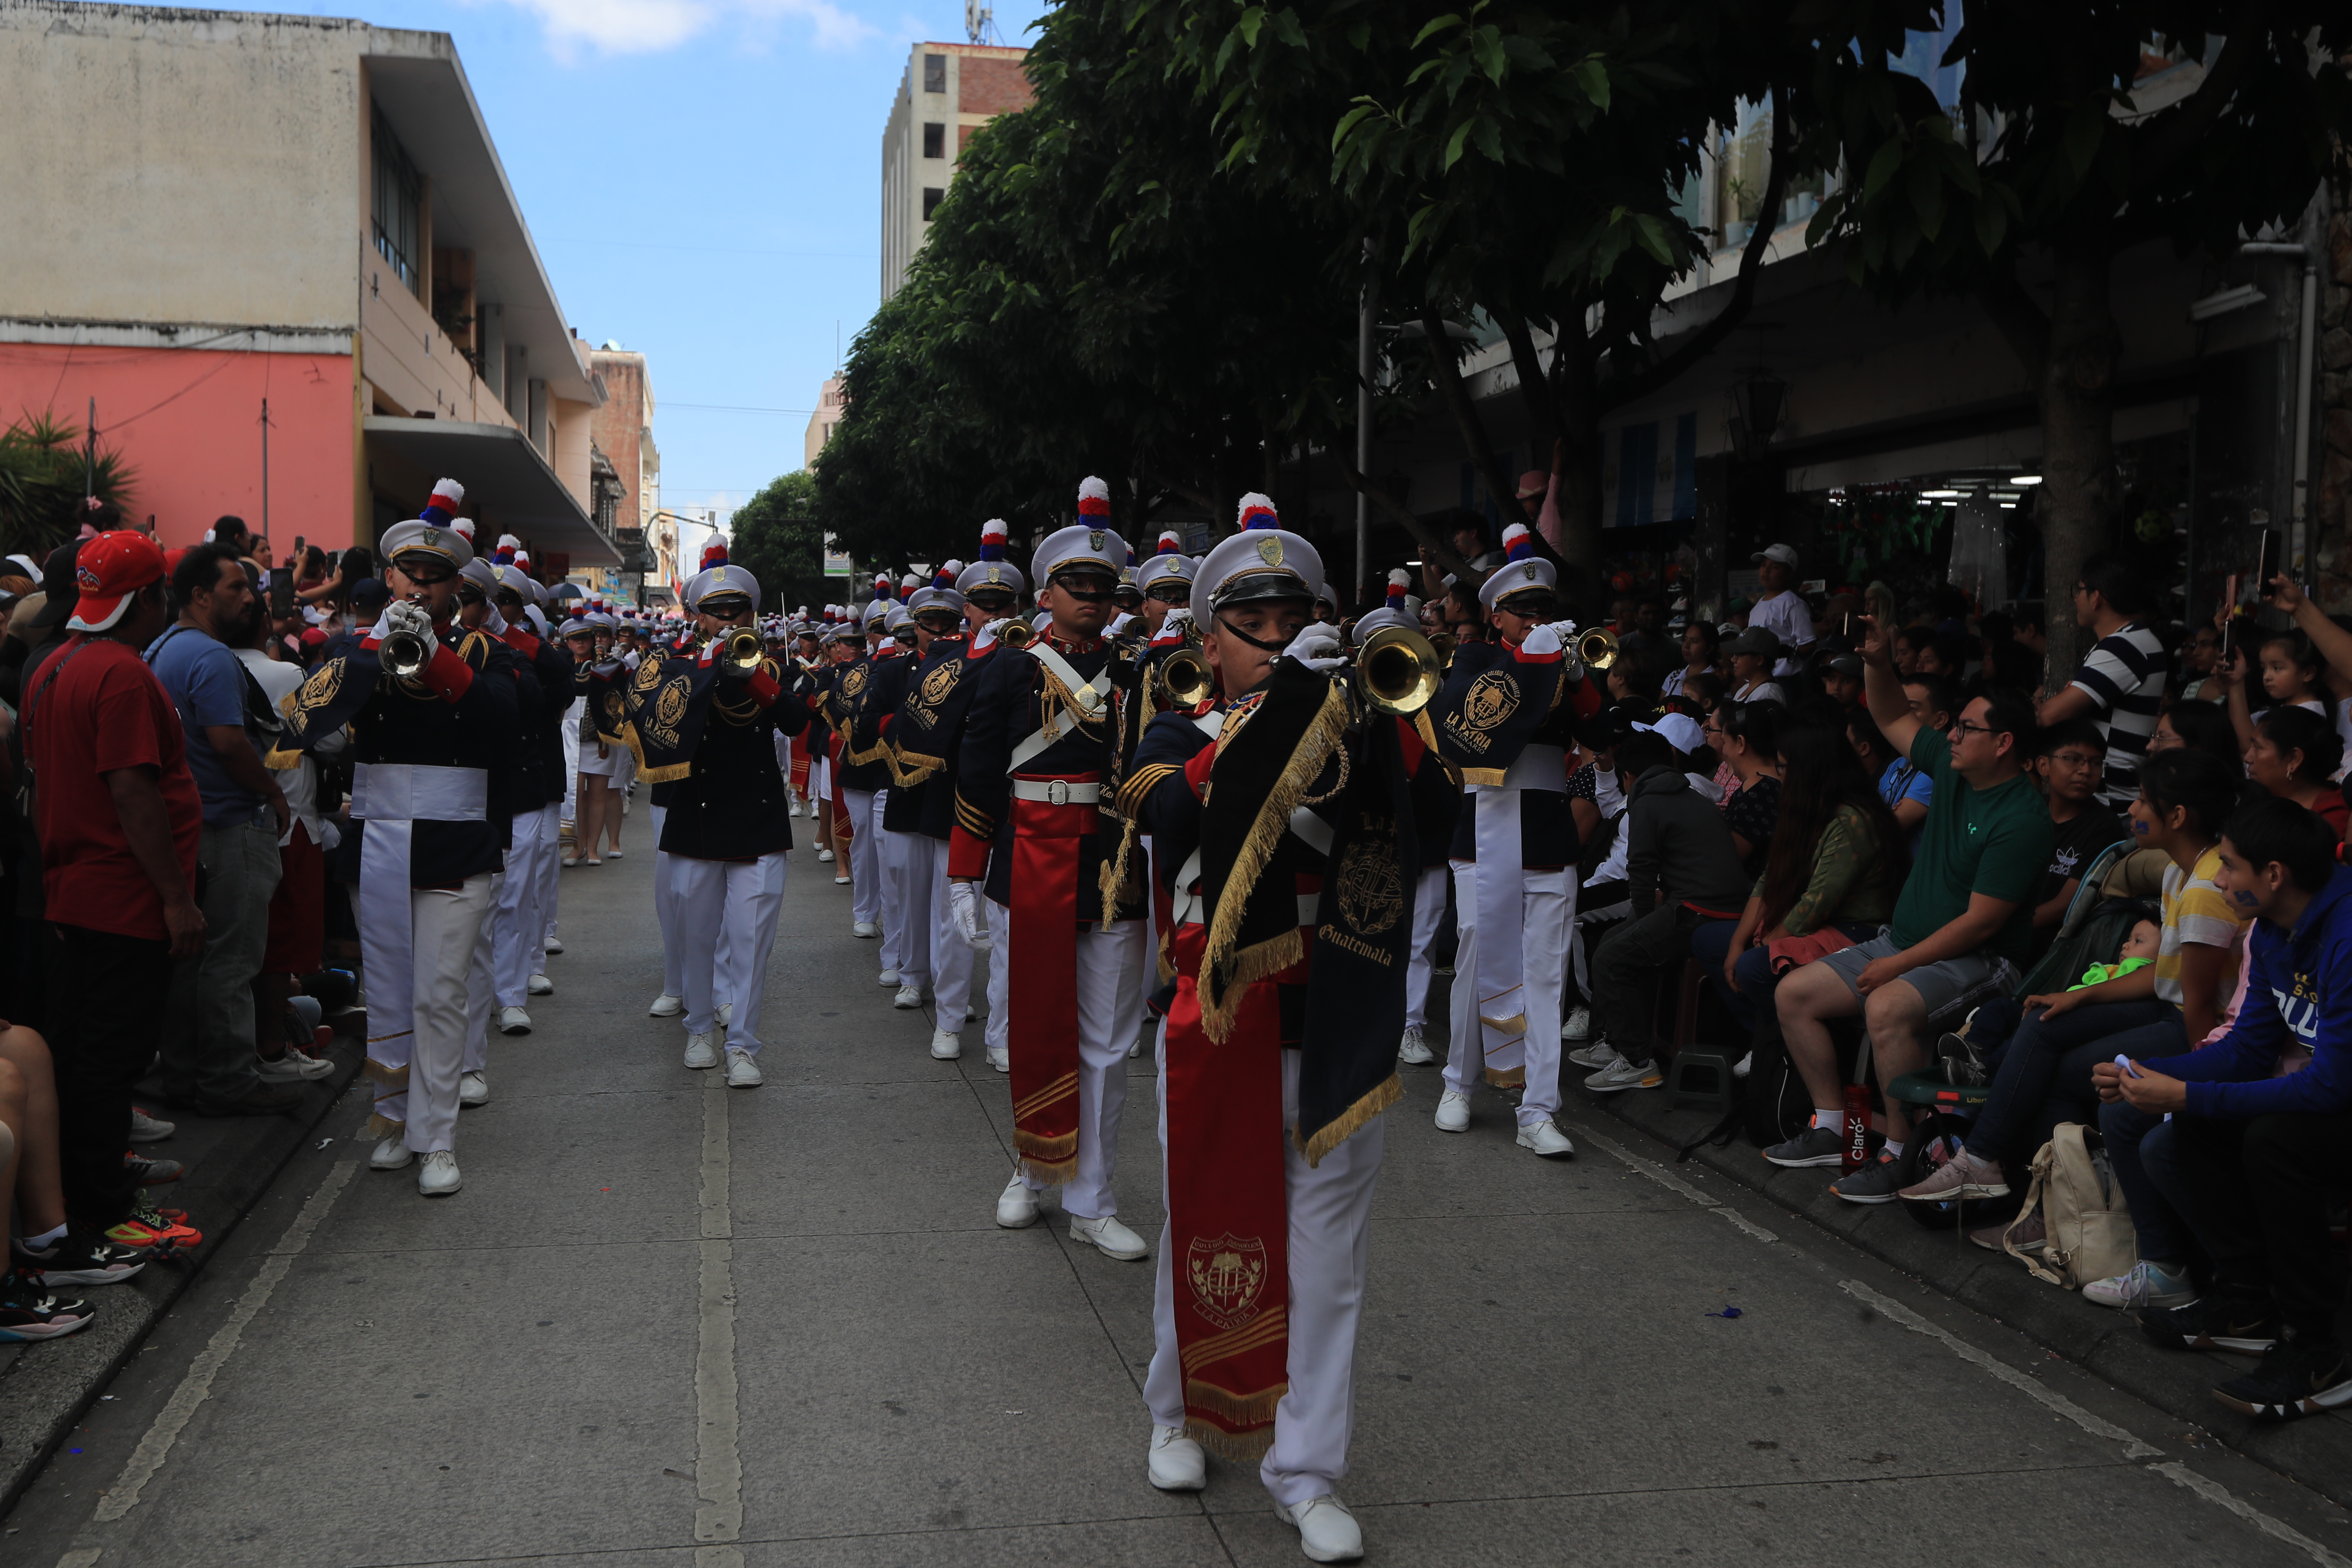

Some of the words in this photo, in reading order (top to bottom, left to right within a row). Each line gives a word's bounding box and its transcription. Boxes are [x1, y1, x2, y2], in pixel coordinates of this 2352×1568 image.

[1504, 674, 1520, 698] EVANGELICO
[840, 695, 854, 710] PATRI
[905, 701, 932, 730] CENTENARIO
[907, 691, 918, 705] LA
[916, 700, 939, 726] PATRIA
[643, 726, 677, 749] CENTENARIO
[645, 716, 653, 729] LA
[653, 722, 680, 745] PATRIA
[1443, 722, 1485, 754] CENTENARIO
[1446, 711, 1460, 726] LA
[1458, 720, 1492, 750] PATRIA
[1447, 734, 1471, 753] GUATEMALA
[1319, 924, 1393, 967] Guatemala
[1852, 1123, 1865, 1161] Claro
[1194, 1240, 1224, 1249] COLEGIO
[1202, 1309, 1214, 1321] LA
[1215, 1312, 1250, 1329] PATRIA
